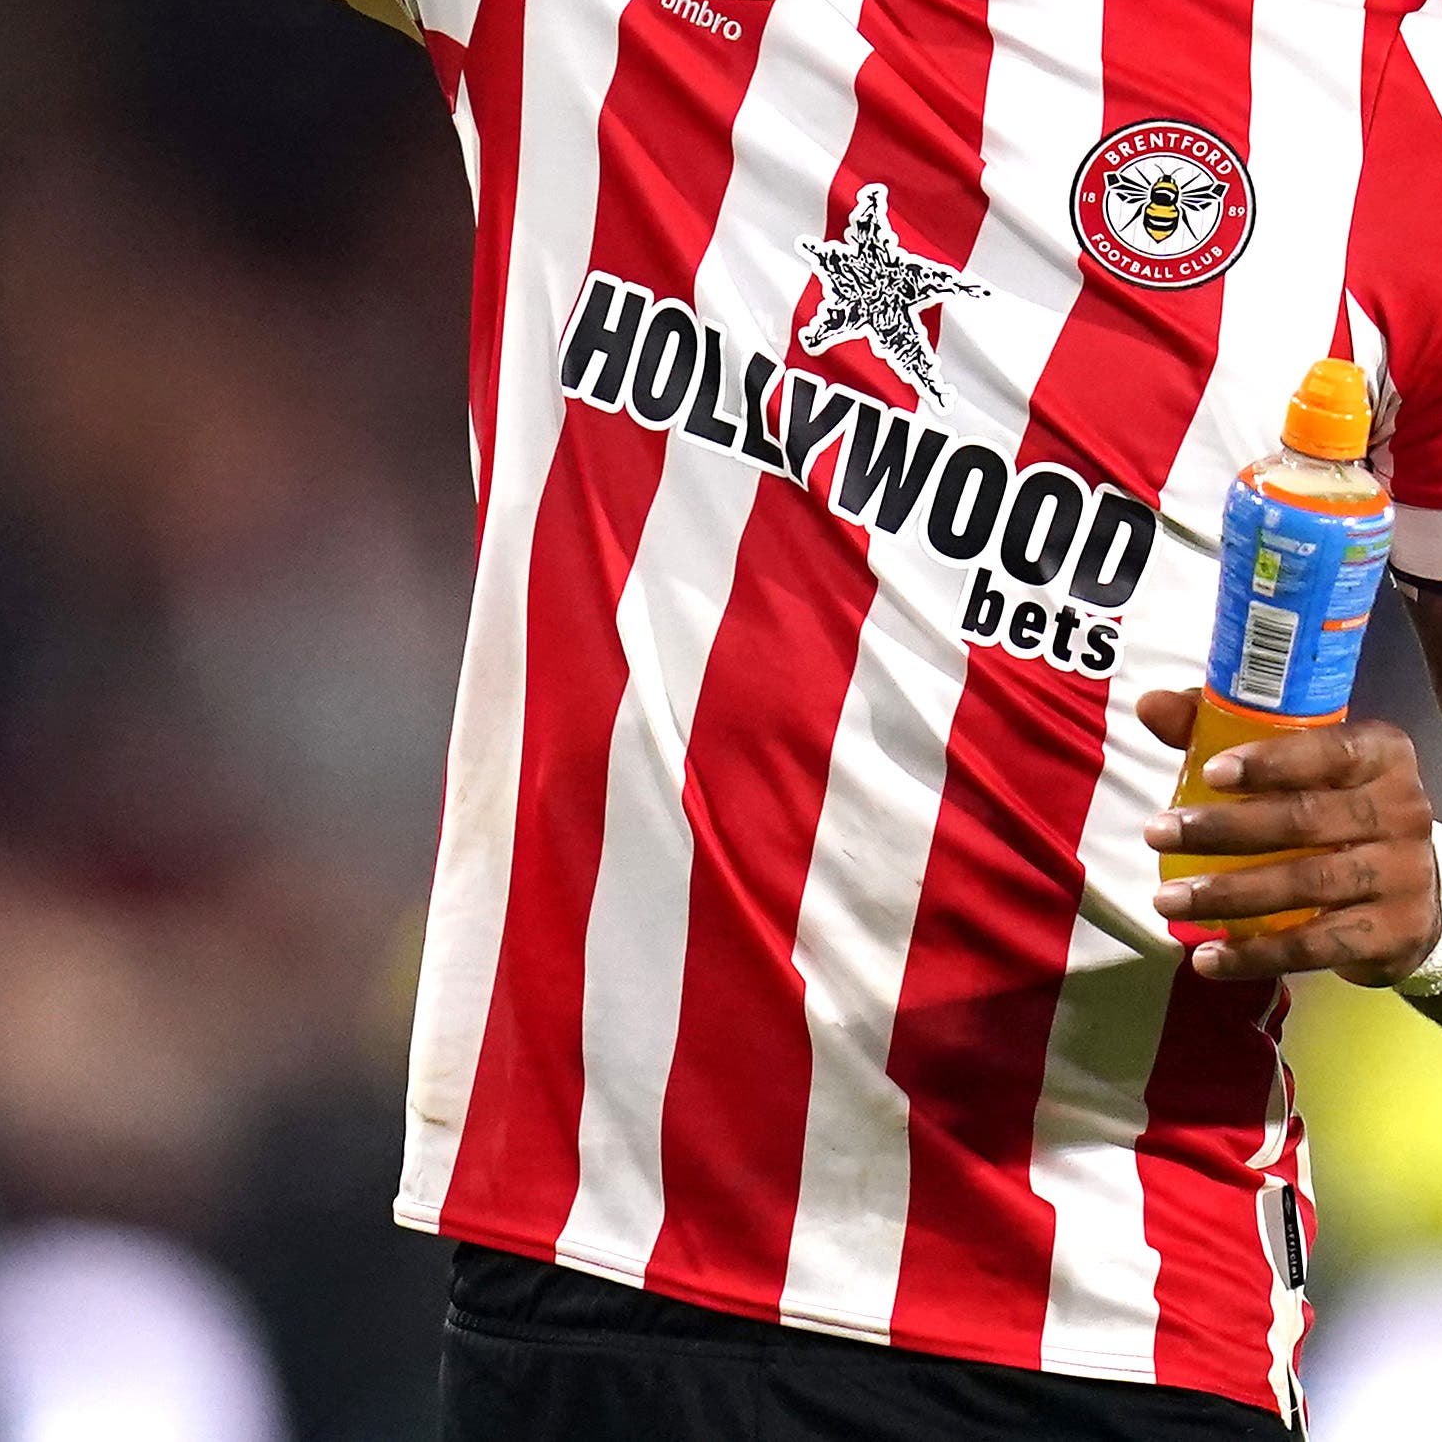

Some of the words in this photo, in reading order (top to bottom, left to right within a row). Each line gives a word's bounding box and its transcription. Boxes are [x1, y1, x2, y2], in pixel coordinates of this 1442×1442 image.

[1104, 132, 1233, 175] BRENTFORD
[1082, 191, 1096, 203] 18
[1227, 205, 1246, 217] 89
[1091, 233, 1174, 279] FOOTBALL
[1179, 245, 1224, 275] CLUB
[561, 280, 1157, 608] HOLLYWOOD
[962, 568, 1119, 671] bets
